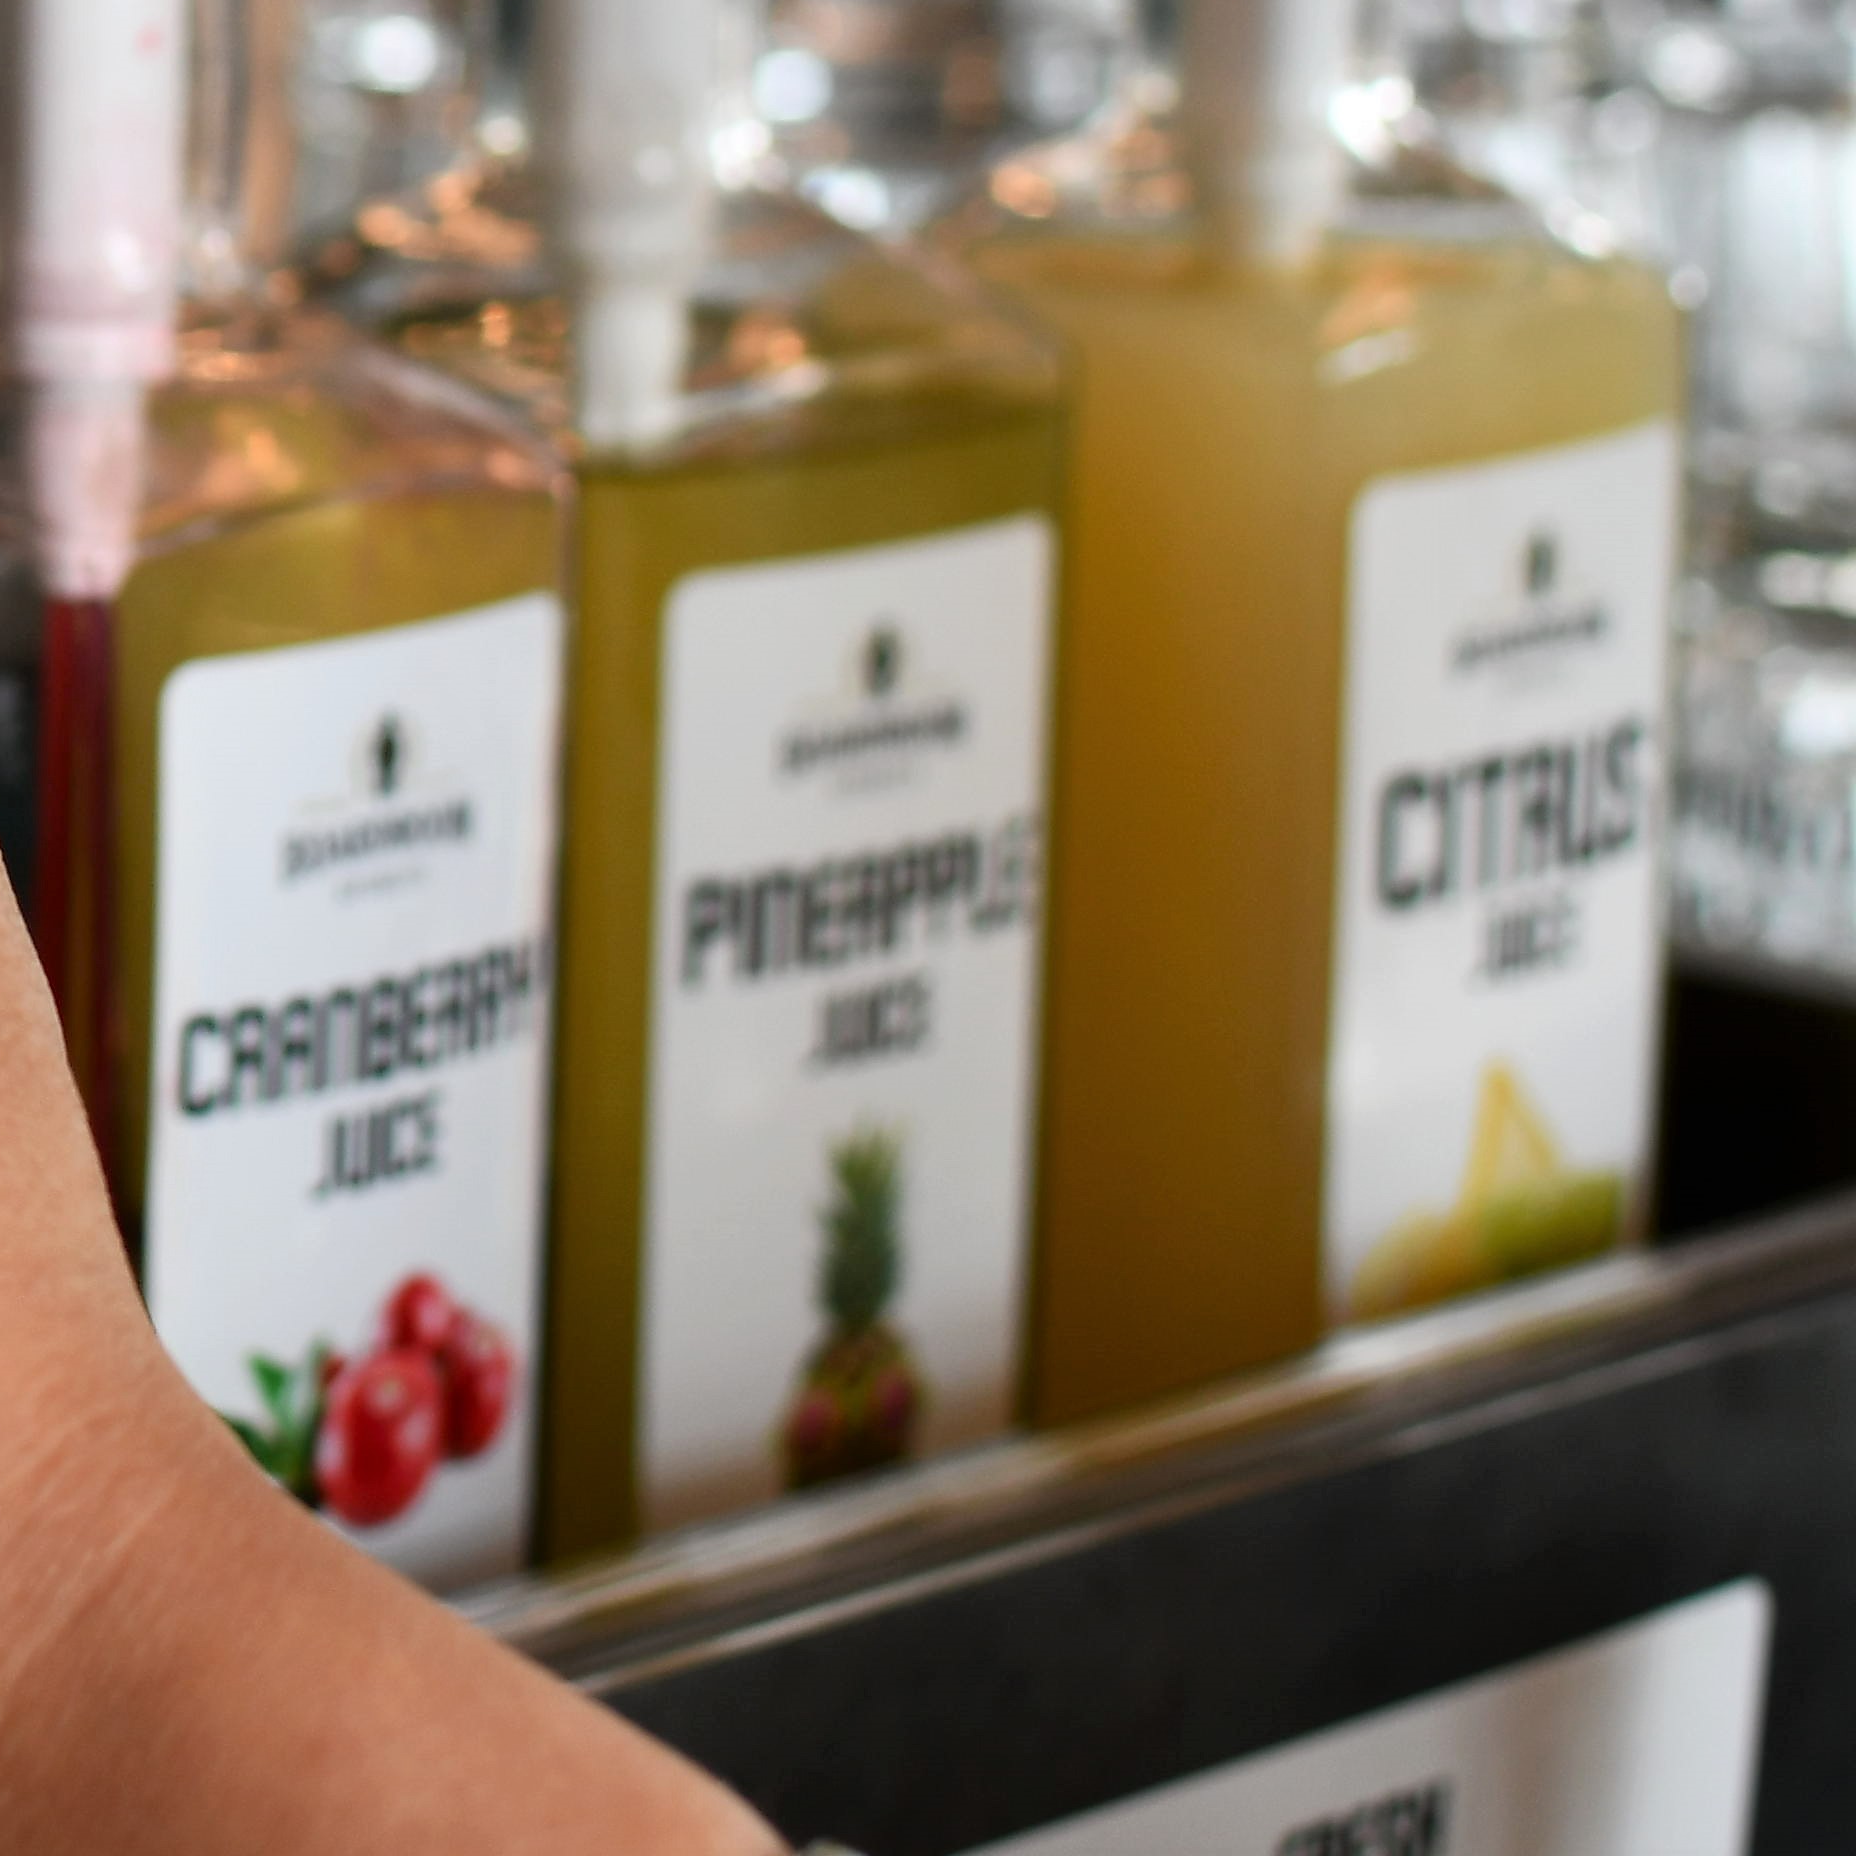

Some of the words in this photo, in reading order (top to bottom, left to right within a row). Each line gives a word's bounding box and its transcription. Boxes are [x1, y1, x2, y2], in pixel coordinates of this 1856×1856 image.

[680, 812, 1040, 992] PINEAPPLE
[1374, 718, 1644, 912] CITRUS
[176, 932, 552, 1118] CRANBERRY
[312, 1086, 442, 1200] JUICE
